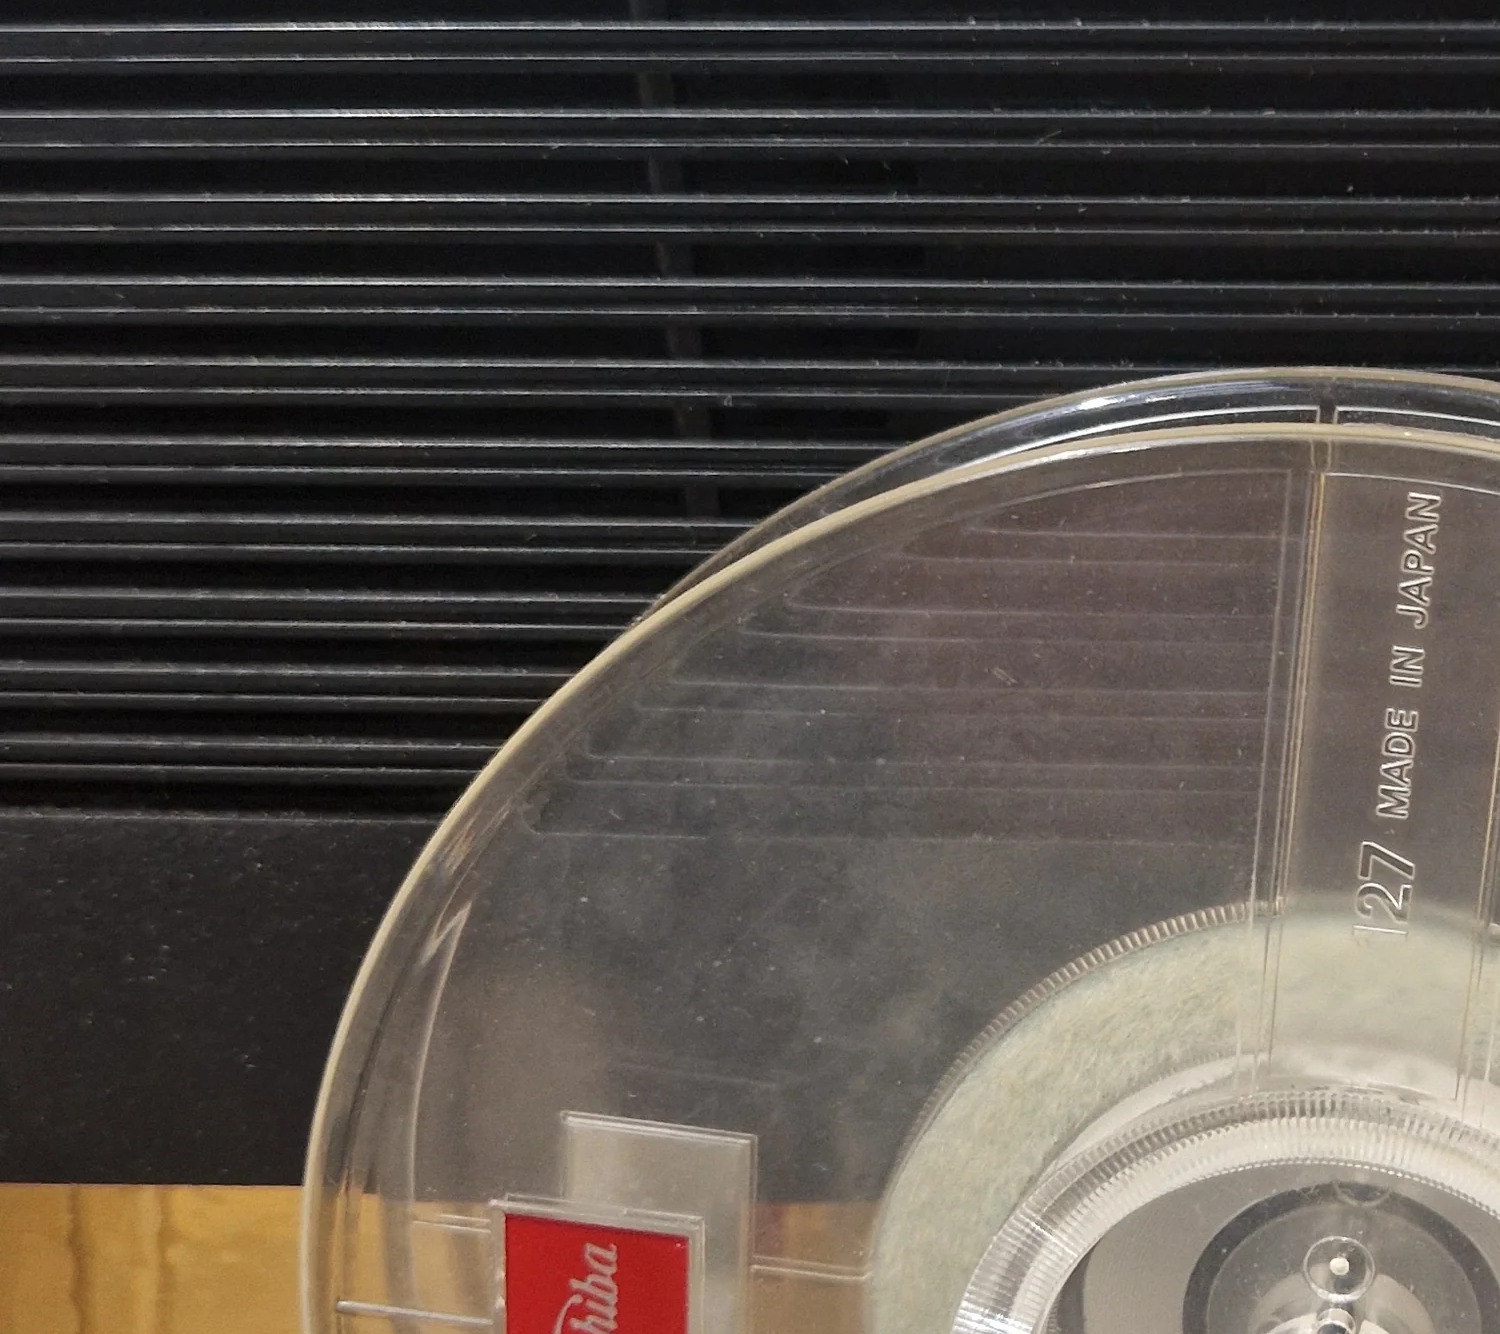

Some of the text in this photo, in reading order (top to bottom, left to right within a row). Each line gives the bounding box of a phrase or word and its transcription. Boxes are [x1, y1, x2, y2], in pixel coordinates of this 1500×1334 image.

[1395, 489, 1442, 629] JAPAN
[1389, 644, 1426, 689] IN
[1376, 706, 1419, 820] MADE
